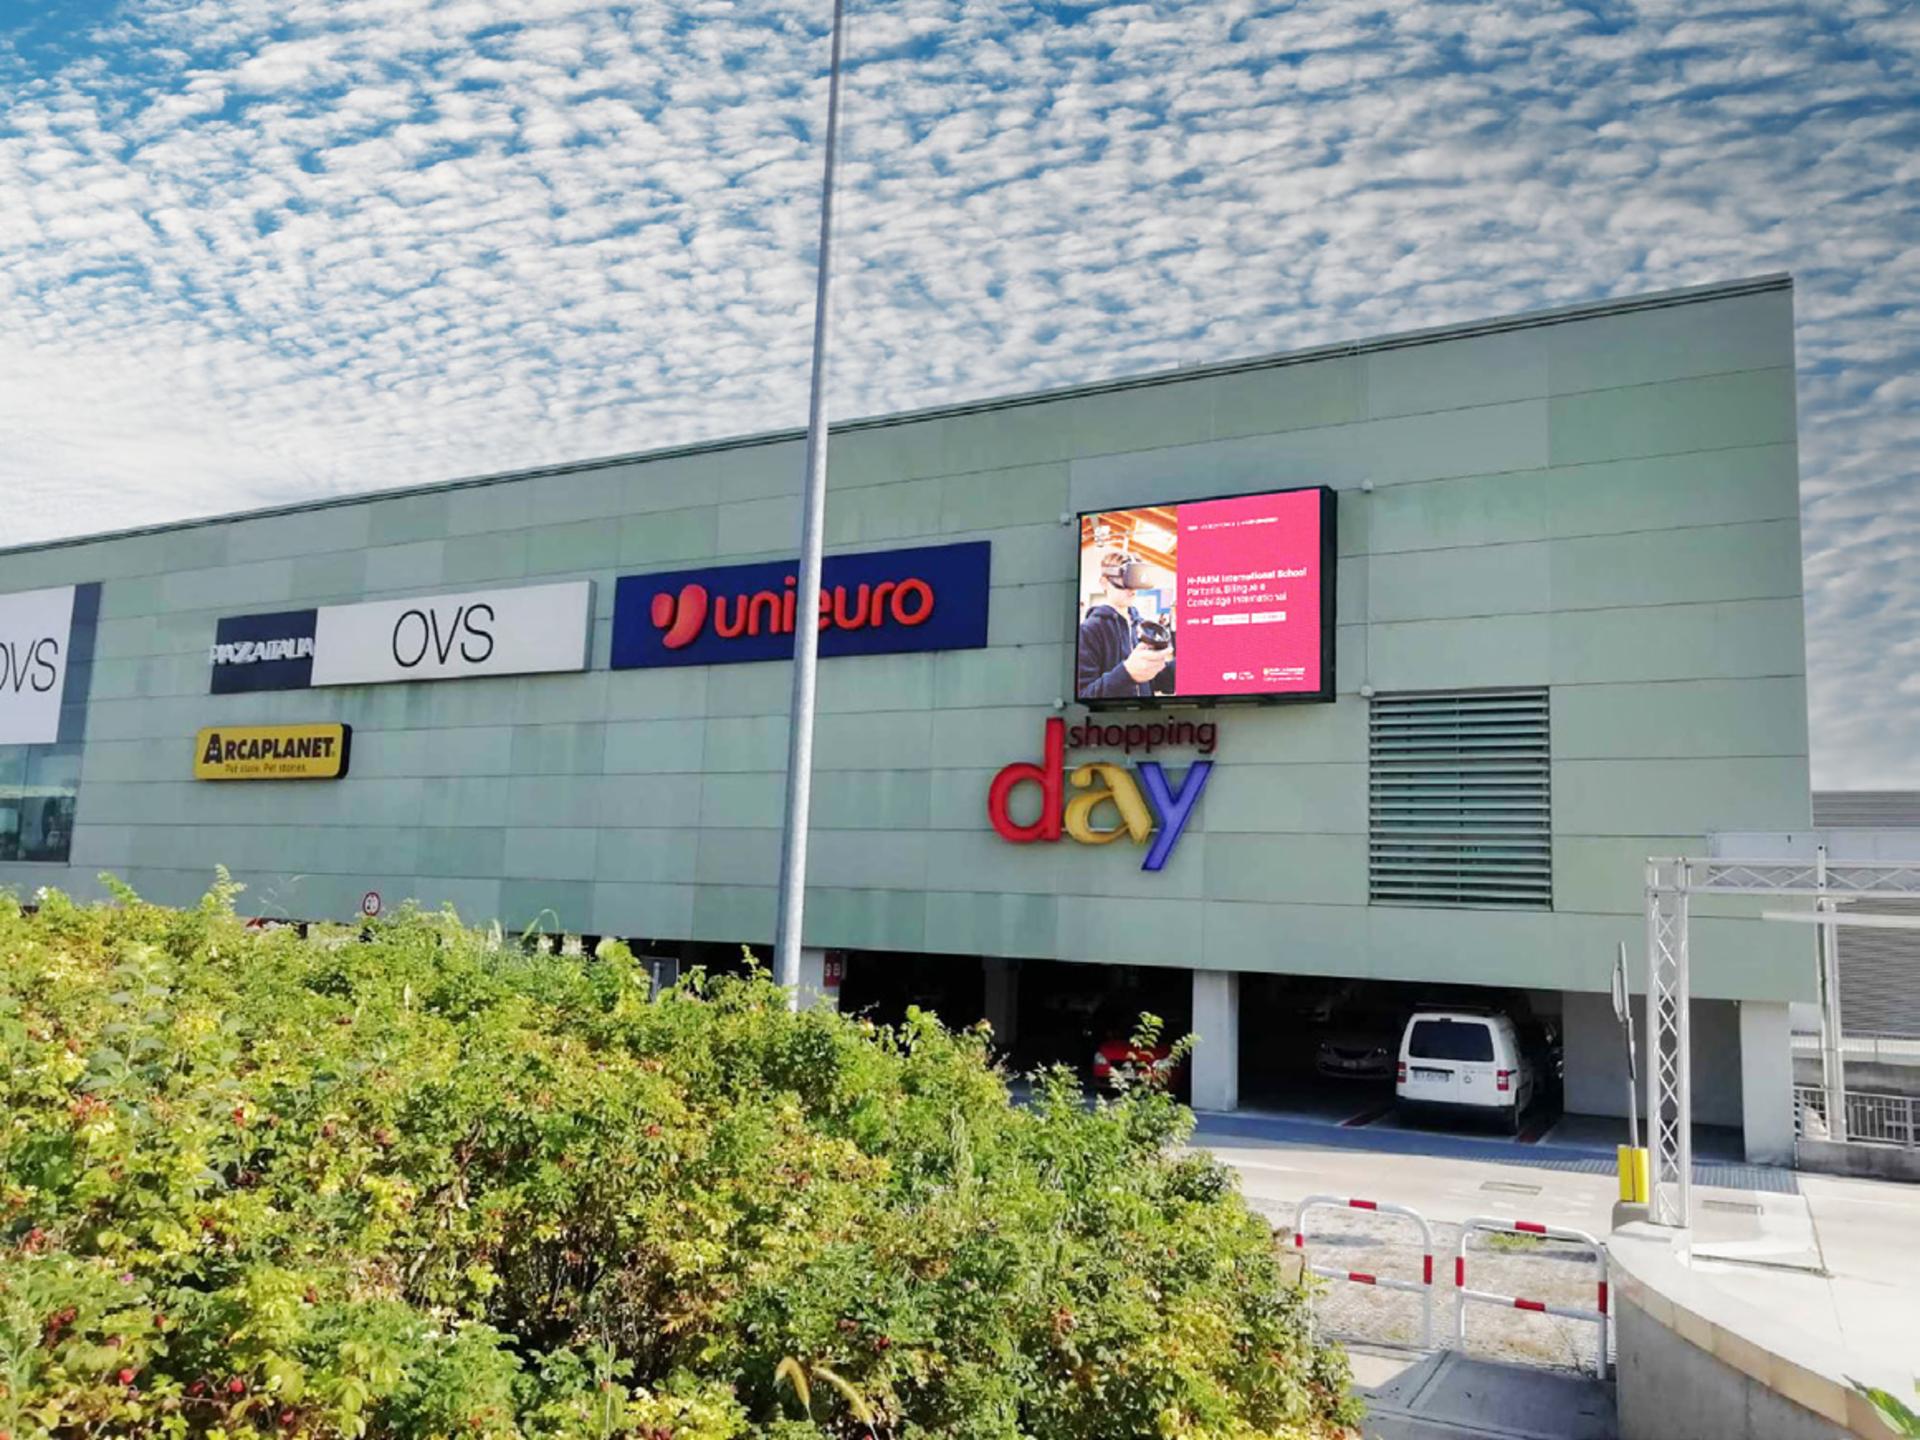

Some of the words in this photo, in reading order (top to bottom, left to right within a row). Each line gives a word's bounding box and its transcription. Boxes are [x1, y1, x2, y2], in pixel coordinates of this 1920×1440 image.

[1222, 570, 1275, 583] International
[1277, 567, 1307, 578] School
[393, 603, 494, 668] OVS
[202, 733, 334, 764] ARCAPLANET
[1069, 715, 1216, 754] shopping
[988, 717, 1215, 871] day
